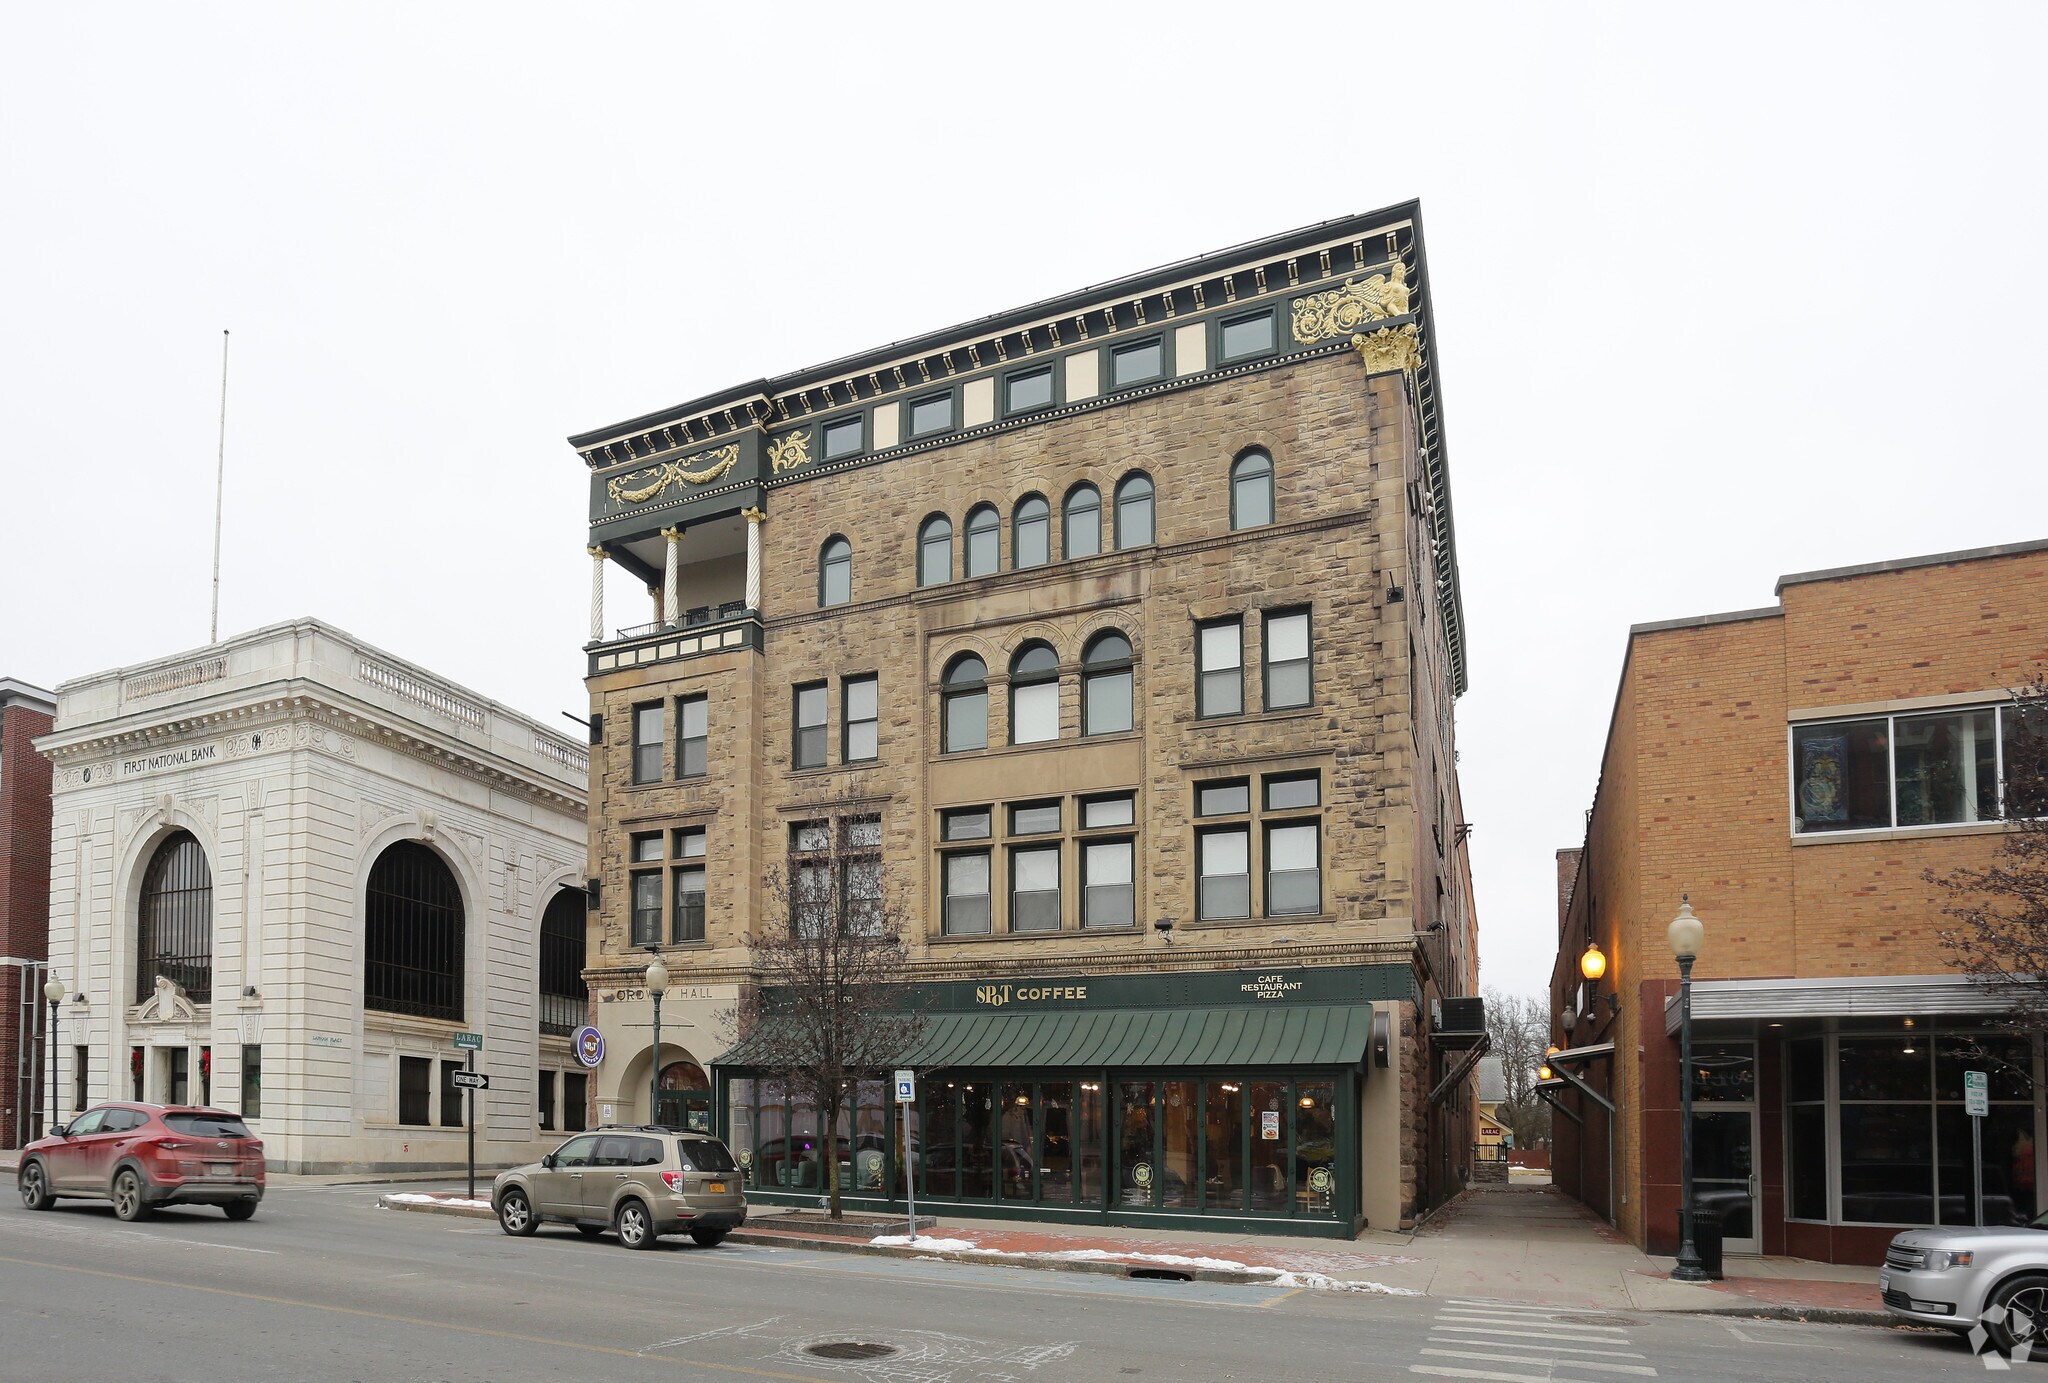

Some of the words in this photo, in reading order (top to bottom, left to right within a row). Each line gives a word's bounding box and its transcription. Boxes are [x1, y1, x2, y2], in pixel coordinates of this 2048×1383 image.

[124, 759, 146, 774] FIRST
[148, 751, 190, 770] NATIONAL
[191, 745, 216, 762] BANK
[1257, 975, 1284, 983] CAFE
[1241, 982, 1303, 991] RESTAURANT
[616, 988, 671, 1001] ORDWY
[681, 987, 713, 999] HALL
[1016, 986, 1087, 1001] COFFEE
[1257, 990, 1284, 999] PIZZA
[456, 1033, 482, 1043] LARAC
[582, 1053, 599, 1063] COFFEE
[456, 1075, 467, 1083] ONE
[1967, 1074, 1973, 1086] 2
